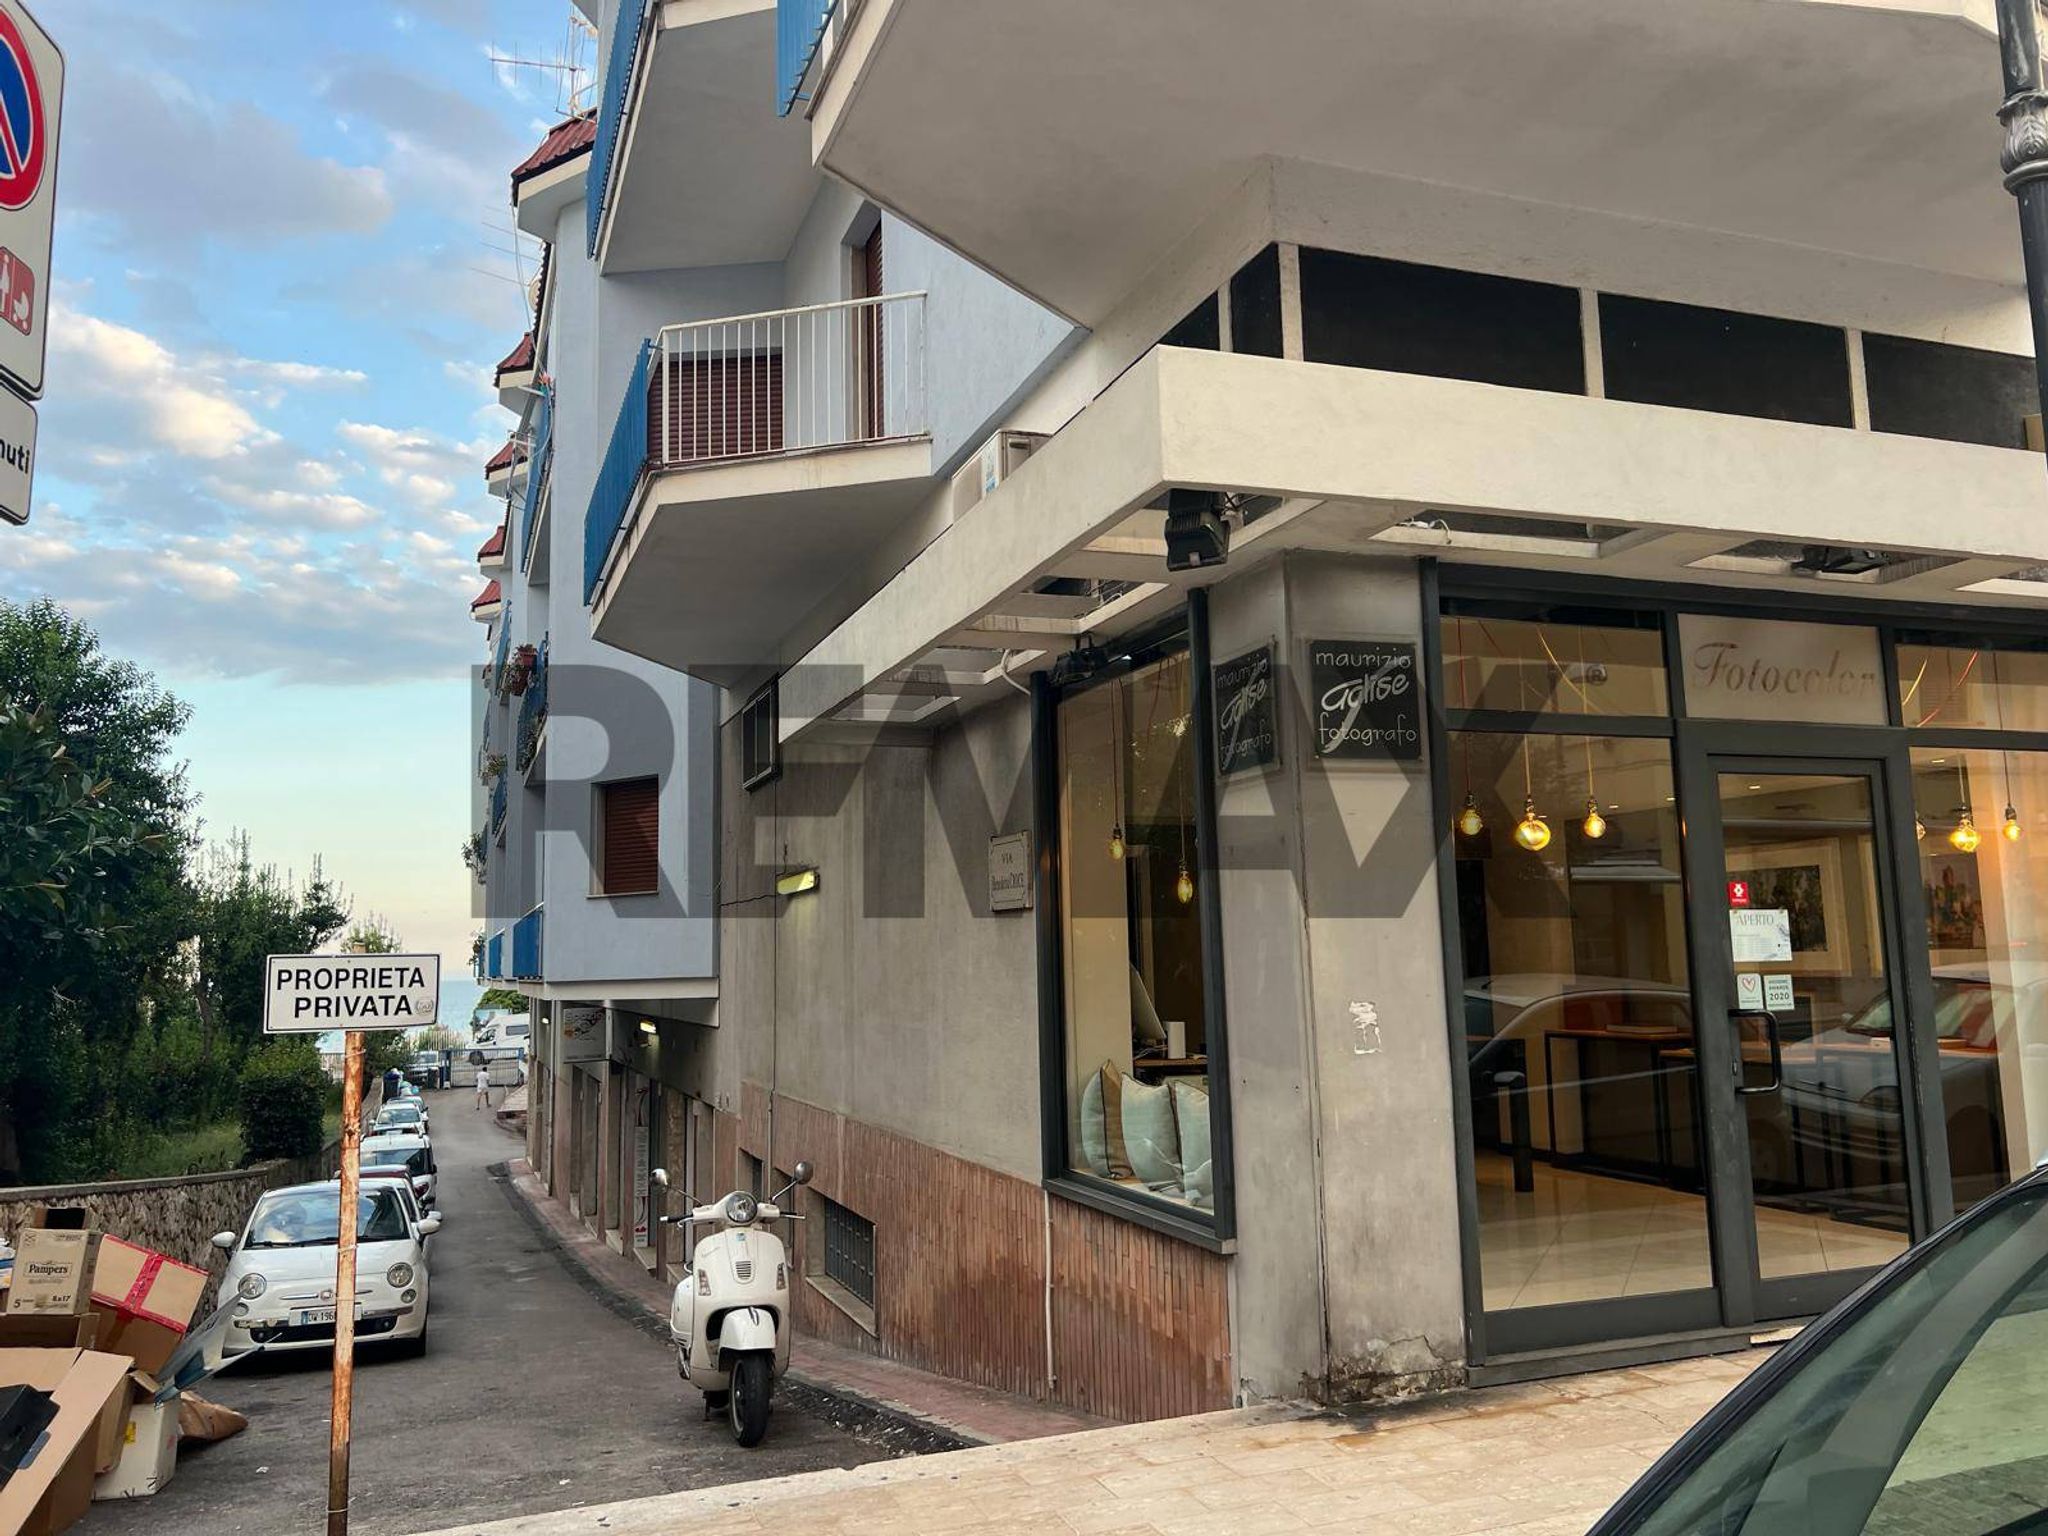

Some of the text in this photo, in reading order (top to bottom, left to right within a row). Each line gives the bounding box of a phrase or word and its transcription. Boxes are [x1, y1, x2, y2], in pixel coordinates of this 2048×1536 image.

[1316, 646, 1411, 667] maurizio
[1319, 711, 1417, 746] fotografo
[1737, 913, 1774, 926] APERTO
[277, 968, 425, 991] PROPRIETA
[294, 995, 412, 1018] PRIVATA
[1769, 992, 1790, 1001] 2020
[29, 1264, 68, 1276] Pampers
